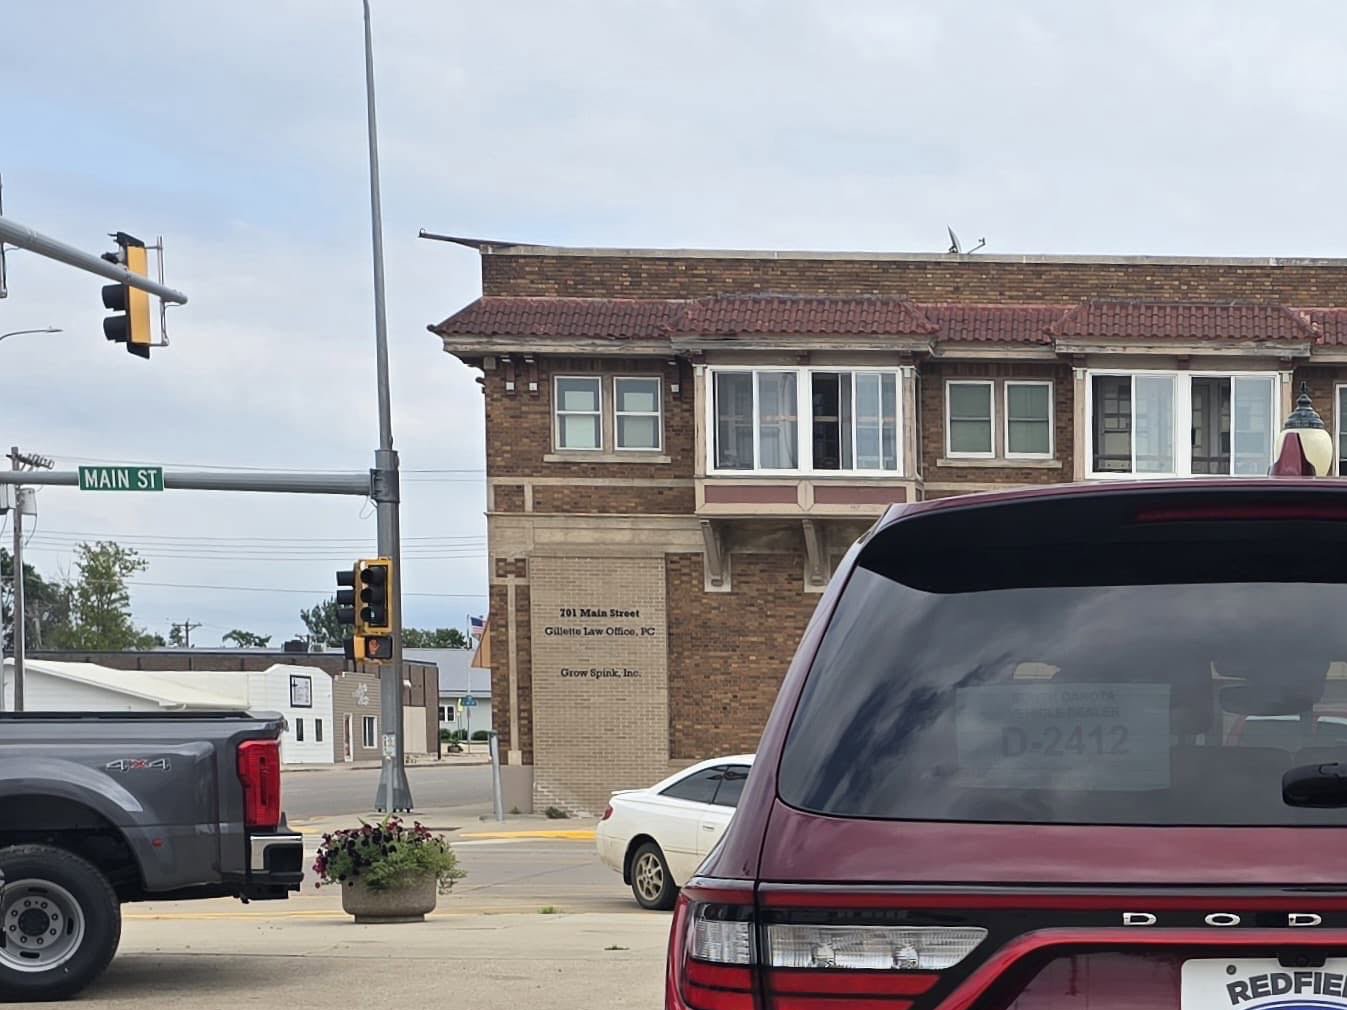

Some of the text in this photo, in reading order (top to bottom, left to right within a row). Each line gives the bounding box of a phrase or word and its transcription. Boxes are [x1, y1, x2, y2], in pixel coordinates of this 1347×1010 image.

[84, 469, 157, 489] MAIN ST
[559, 608, 640, 618] 701 Main Street
[544, 627, 582, 636] Gillette
[584, 627, 604, 636] Law
[640, 627, 656, 636] PC
[560, 668, 588, 678] Grow
[1002, 725, 1129, 758] D-2412
